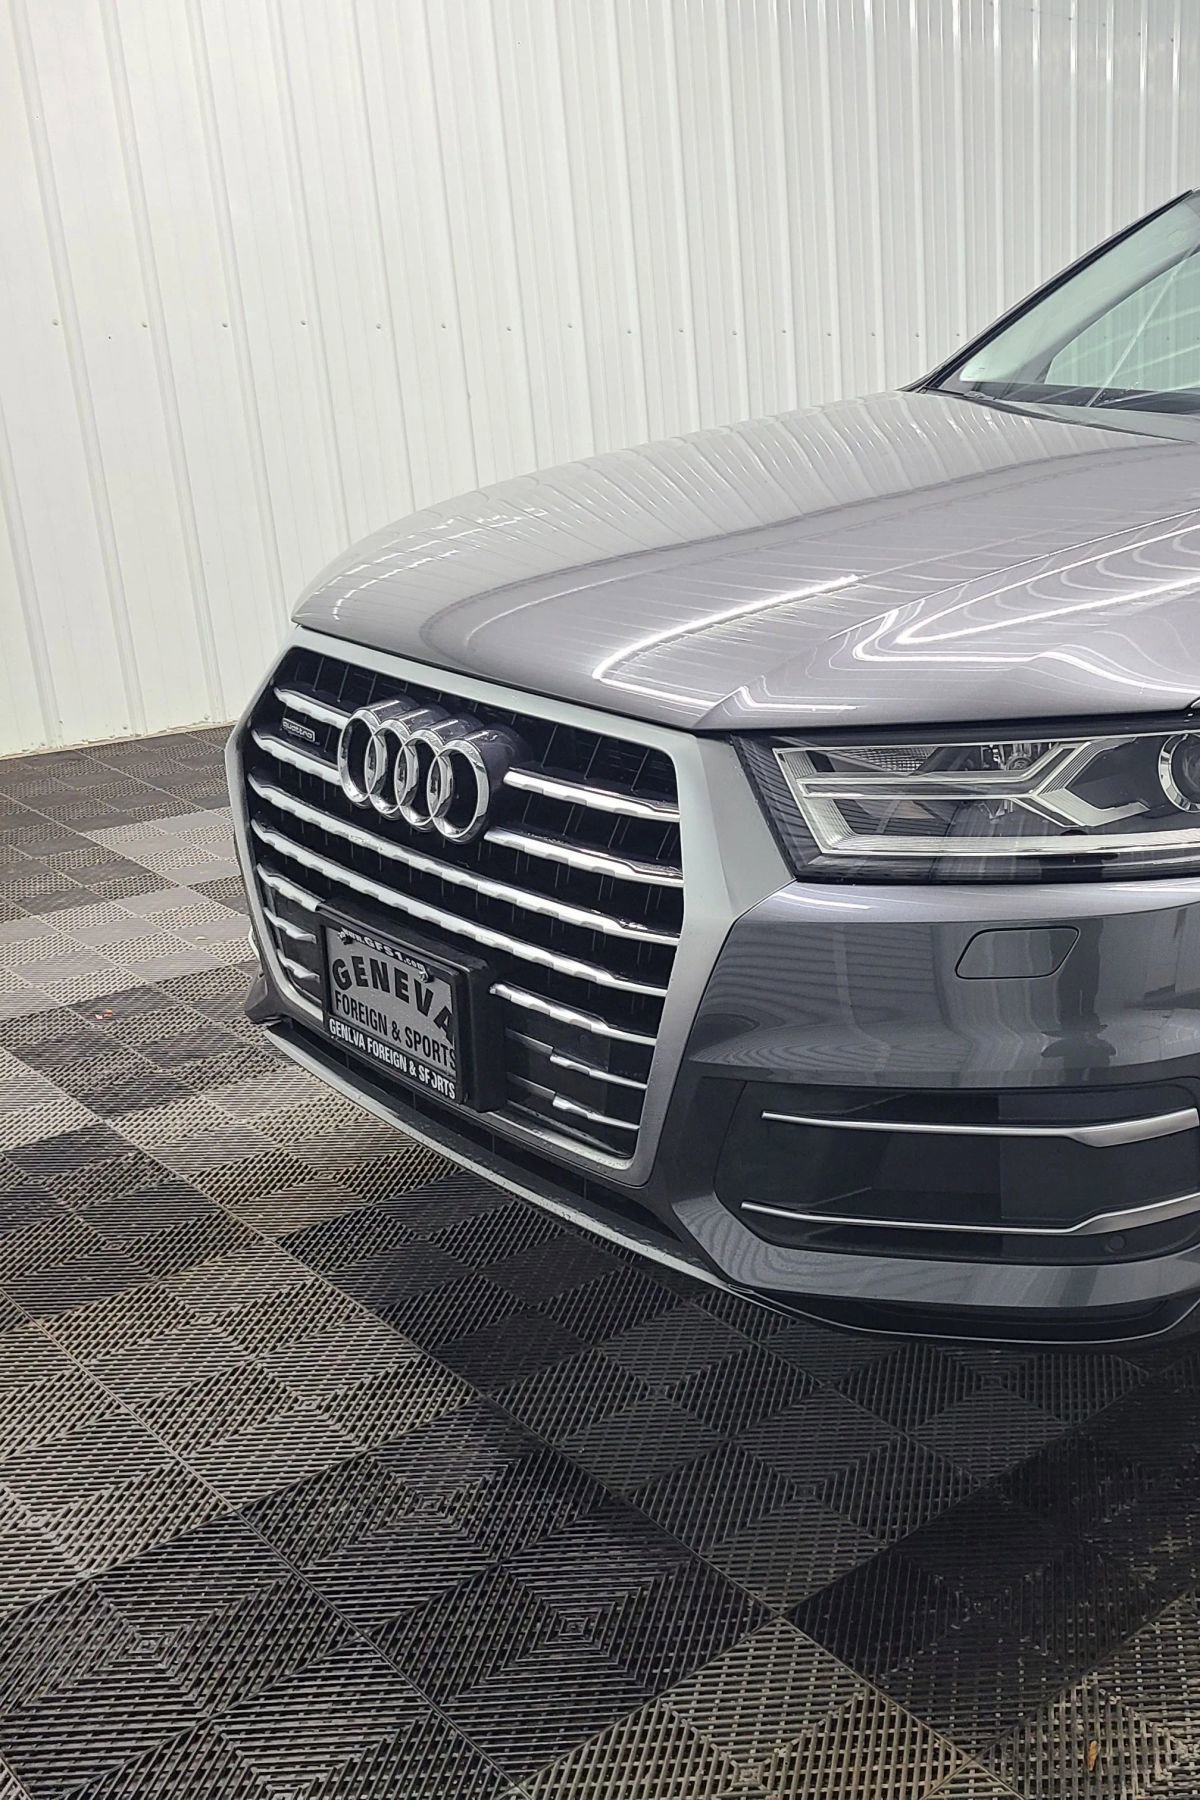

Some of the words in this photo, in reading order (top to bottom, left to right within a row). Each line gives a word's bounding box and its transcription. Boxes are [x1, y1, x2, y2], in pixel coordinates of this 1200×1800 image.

[332, 956, 456, 1049] GENEVA
[335, 990, 388, 1036] FOREIGN
[392, 1021, 401, 1043] &
[405, 1026, 456, 1071] SPORTS
[367, 1037, 407, 1073] FOREIGN
[409, 1060, 417, 1078] &
